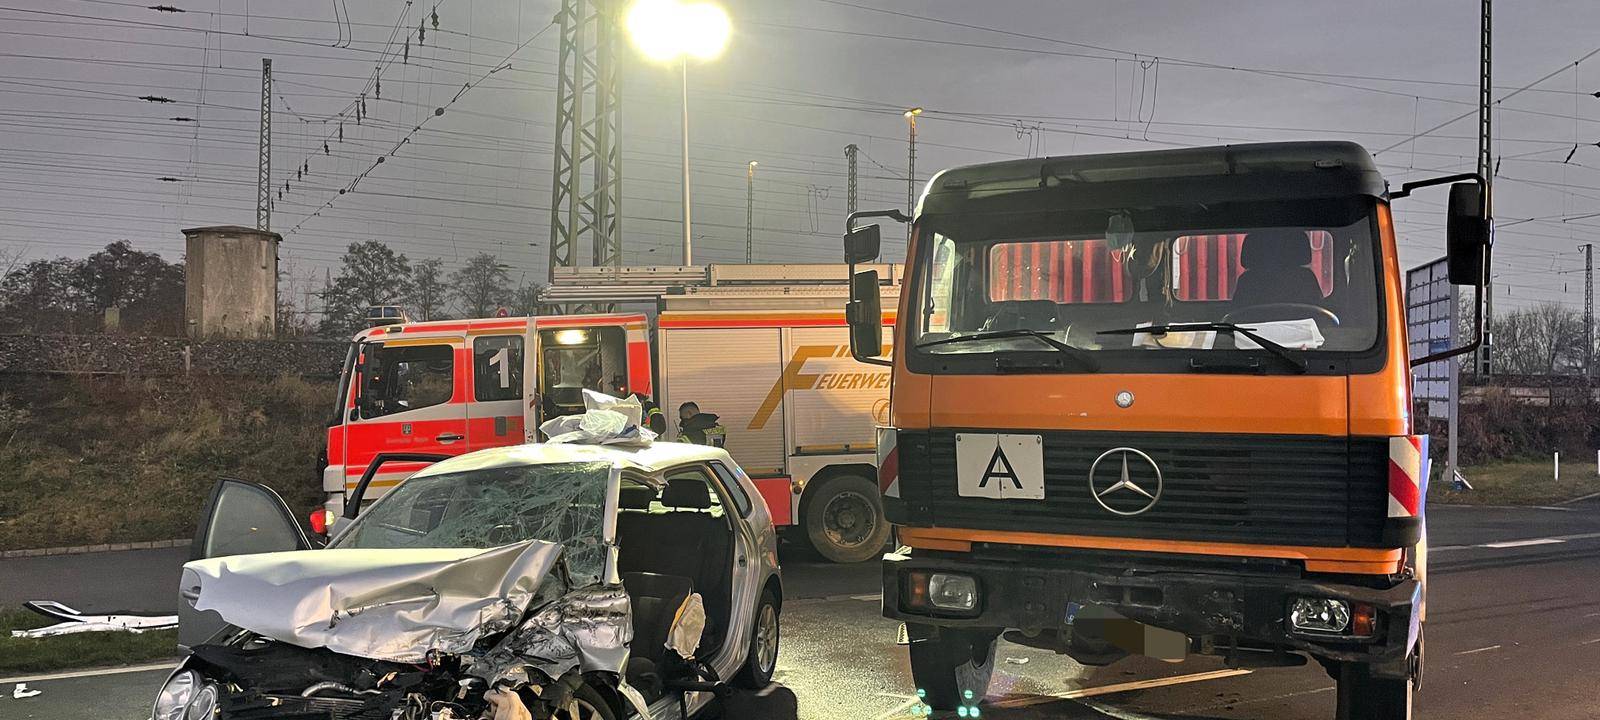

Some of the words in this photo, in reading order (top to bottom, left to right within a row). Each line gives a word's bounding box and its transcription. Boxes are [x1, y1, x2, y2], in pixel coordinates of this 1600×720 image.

[489, 348, 509, 388] 1
[747, 345, 890, 429] FEUERWE
[979, 446, 1023, 489] A
